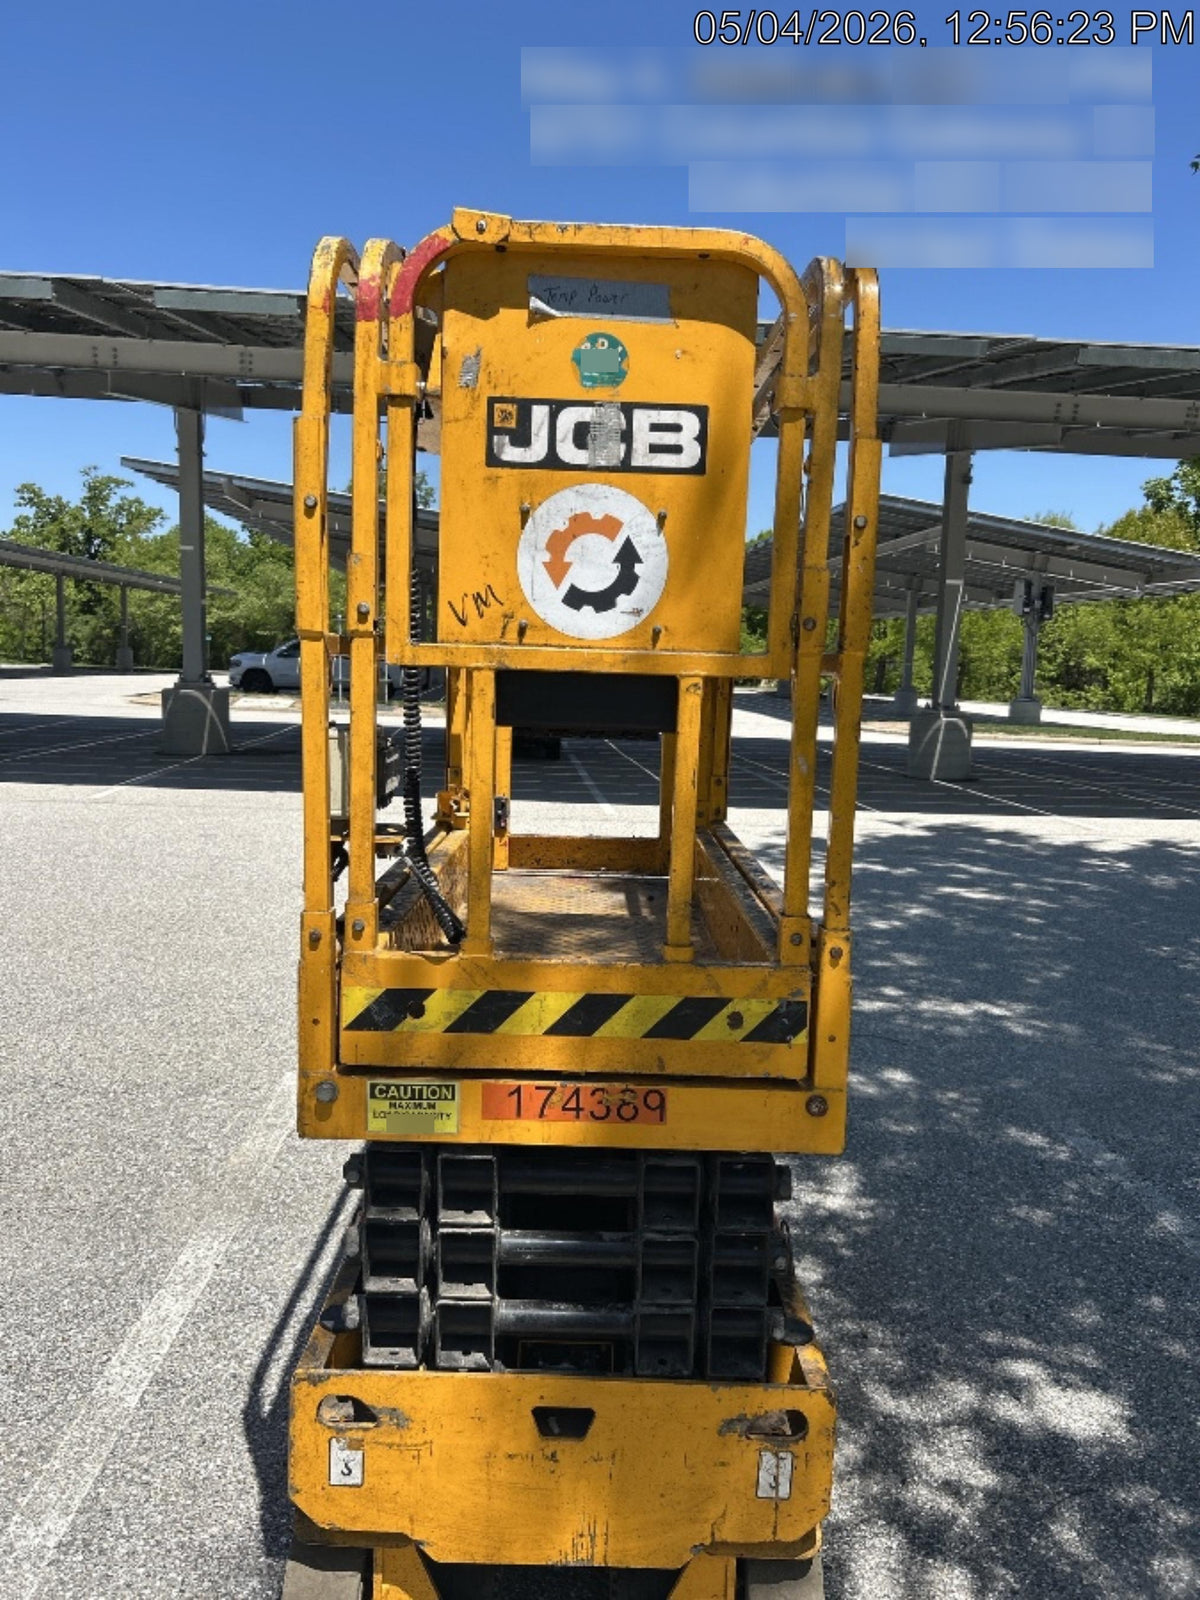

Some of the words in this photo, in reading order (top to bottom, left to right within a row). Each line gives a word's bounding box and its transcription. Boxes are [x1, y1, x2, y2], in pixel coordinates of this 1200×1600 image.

[493, 404, 702, 468] JCB
[374, 1085, 453, 1100] CAUTION
[507, 1084, 666, 1122] 174389
[388, 1101, 437, 1111] MAXIMUM
